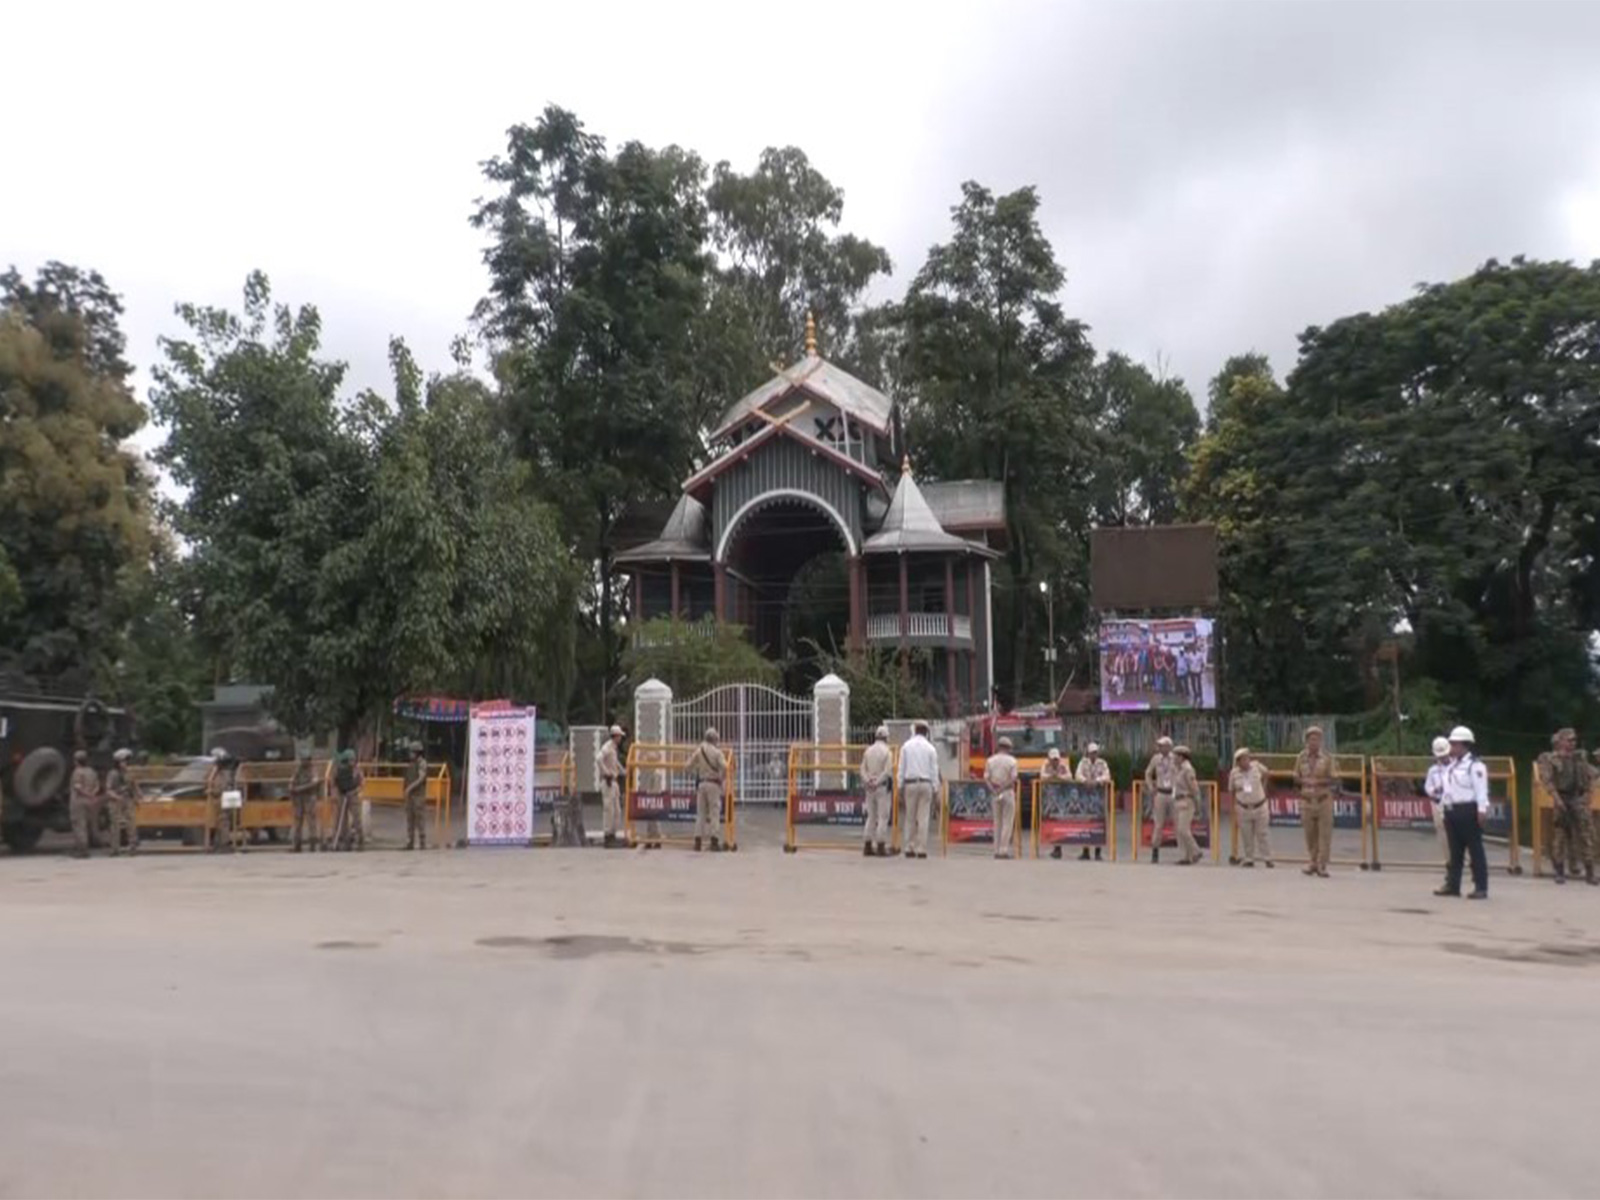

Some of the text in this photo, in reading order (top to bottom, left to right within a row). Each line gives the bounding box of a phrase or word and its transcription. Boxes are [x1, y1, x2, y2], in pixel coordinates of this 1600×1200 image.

[637, 796, 690, 810] IMPHAL WEST
[799, 801, 827, 813] IMPHAL
[834, 801, 855, 814] WEST
[1384, 801, 1426, 818] IMPHAL
